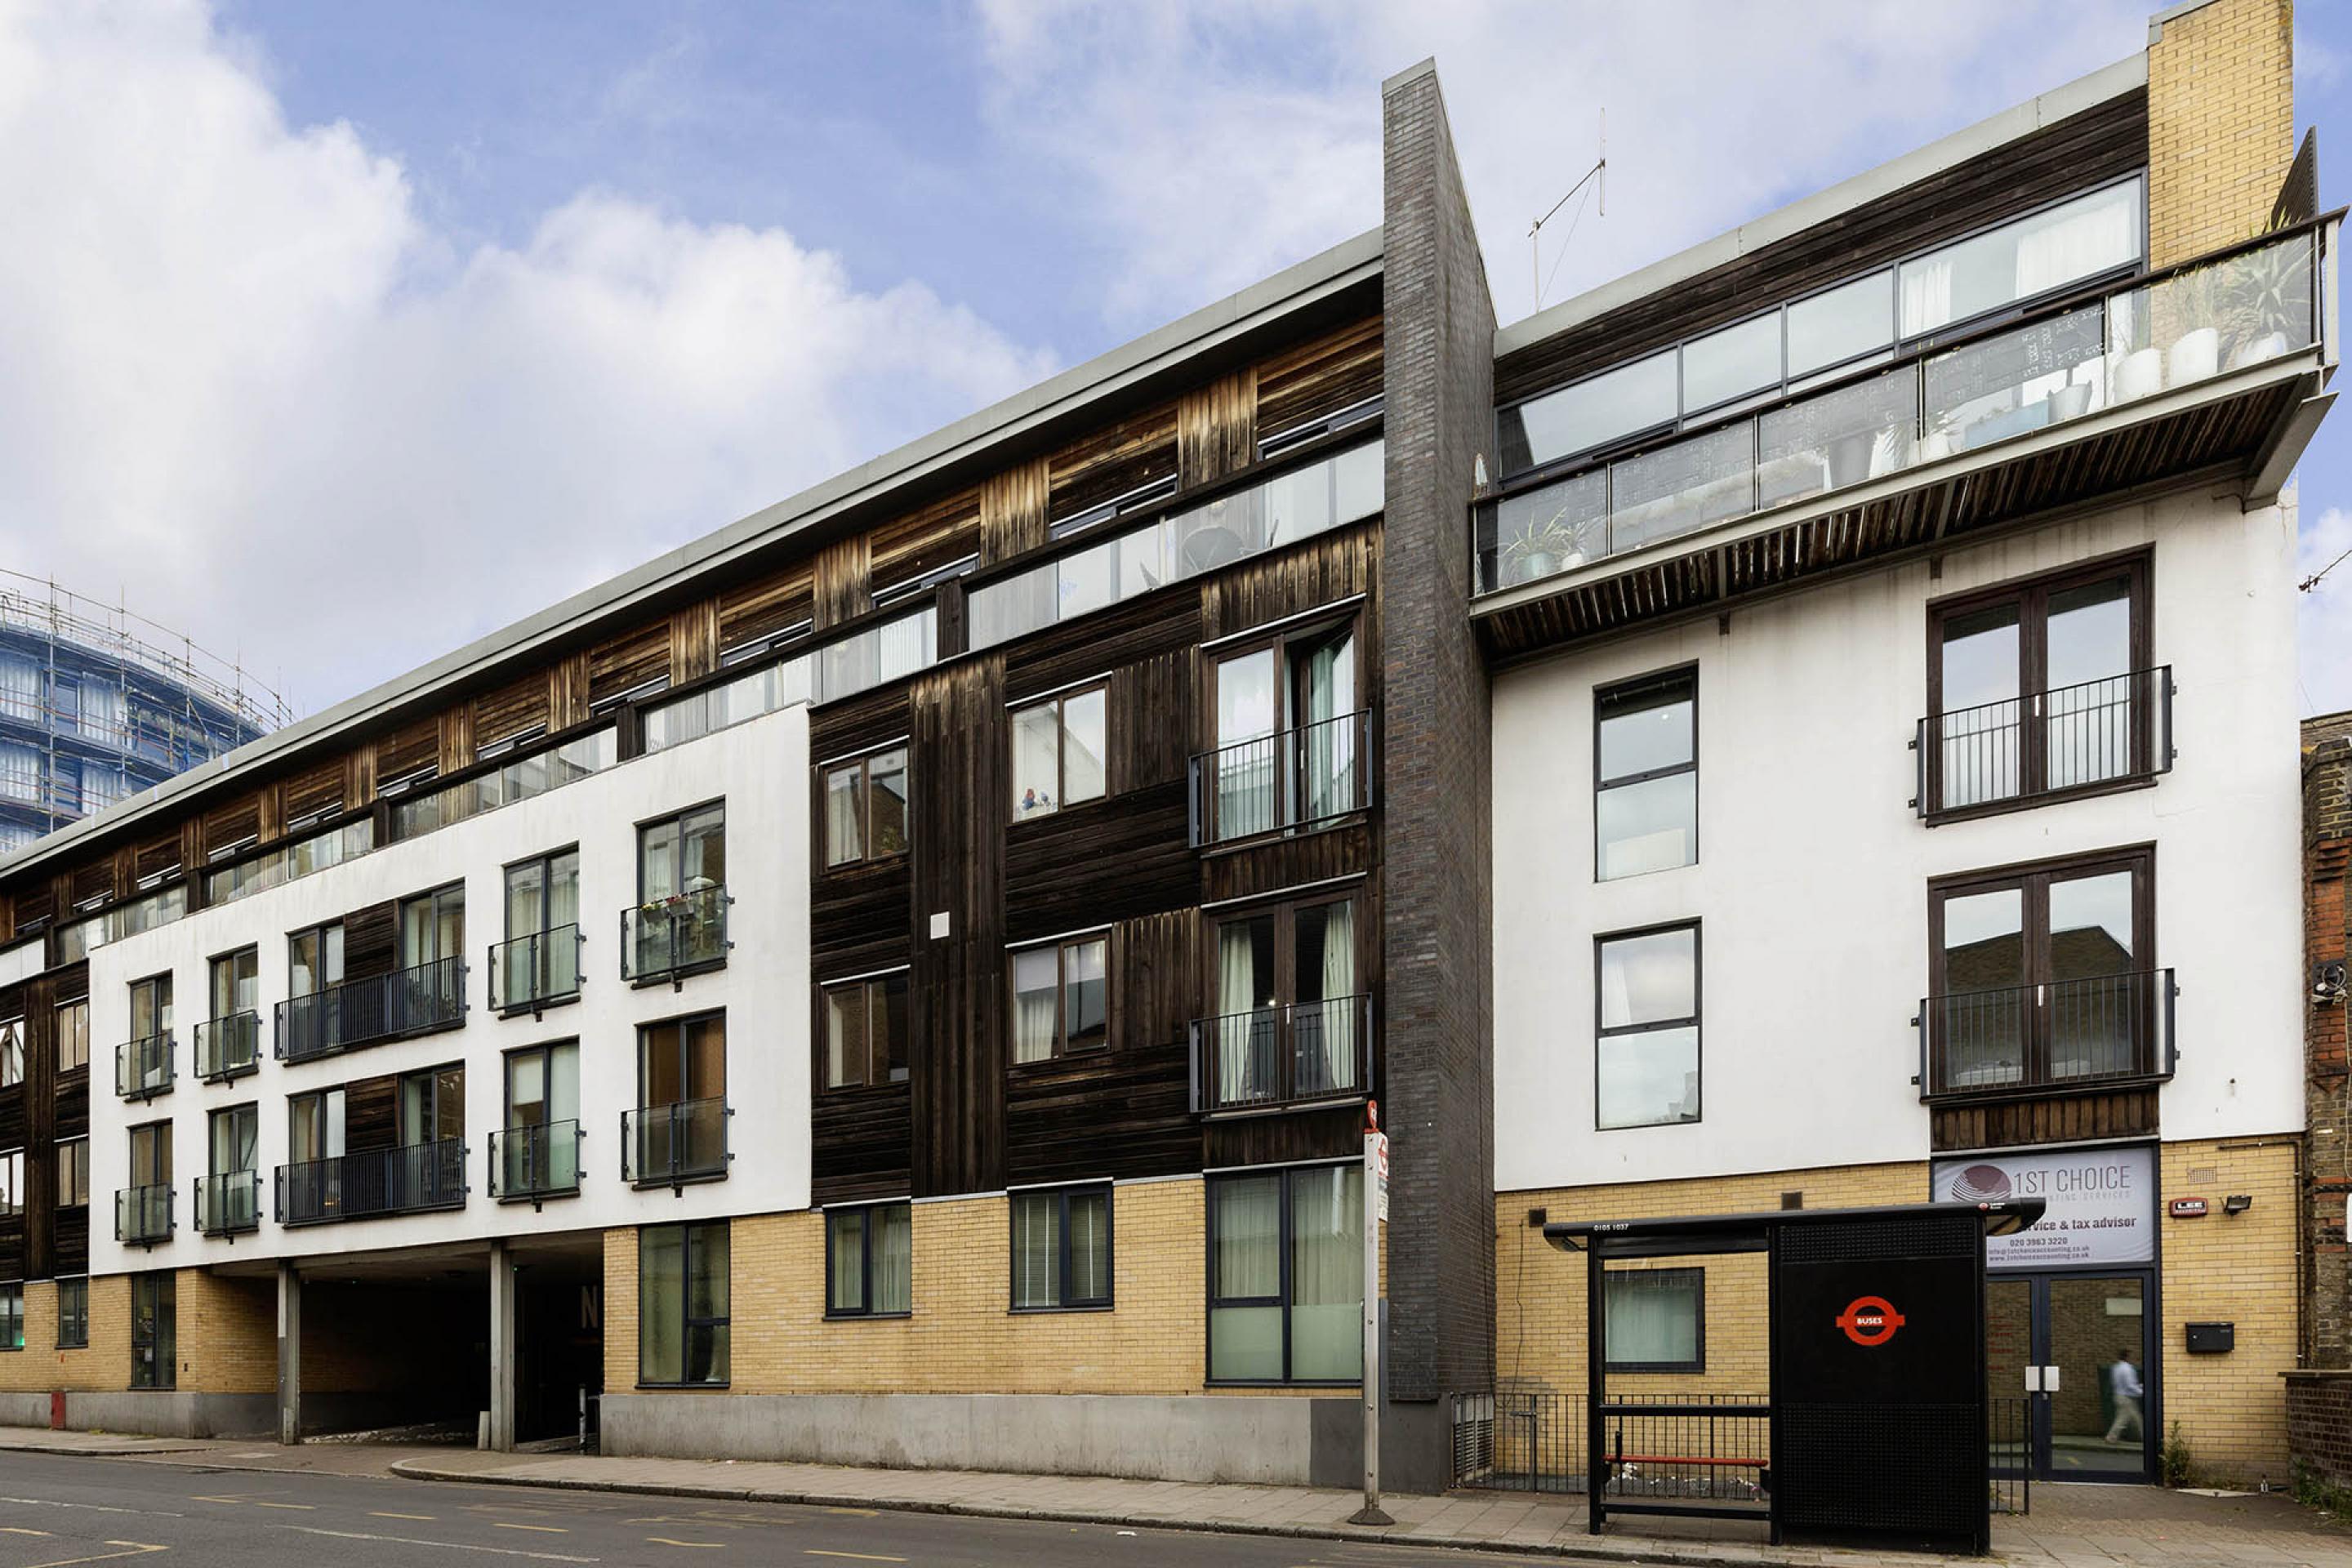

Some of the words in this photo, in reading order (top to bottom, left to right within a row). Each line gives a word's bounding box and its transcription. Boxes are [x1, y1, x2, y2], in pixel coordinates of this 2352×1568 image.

[2014, 1171, 2049, 1193] 1ST
[2056, 1165, 2131, 1192] CHOICE
[2060, 1220, 2069, 1231] &
[2073, 1219, 2090, 1230] tax
[2093, 1216, 2136, 1229] advisor
[2010, 1239, 2025, 1247] 020
[1856, 1316, 1882, 1325] BUSES
